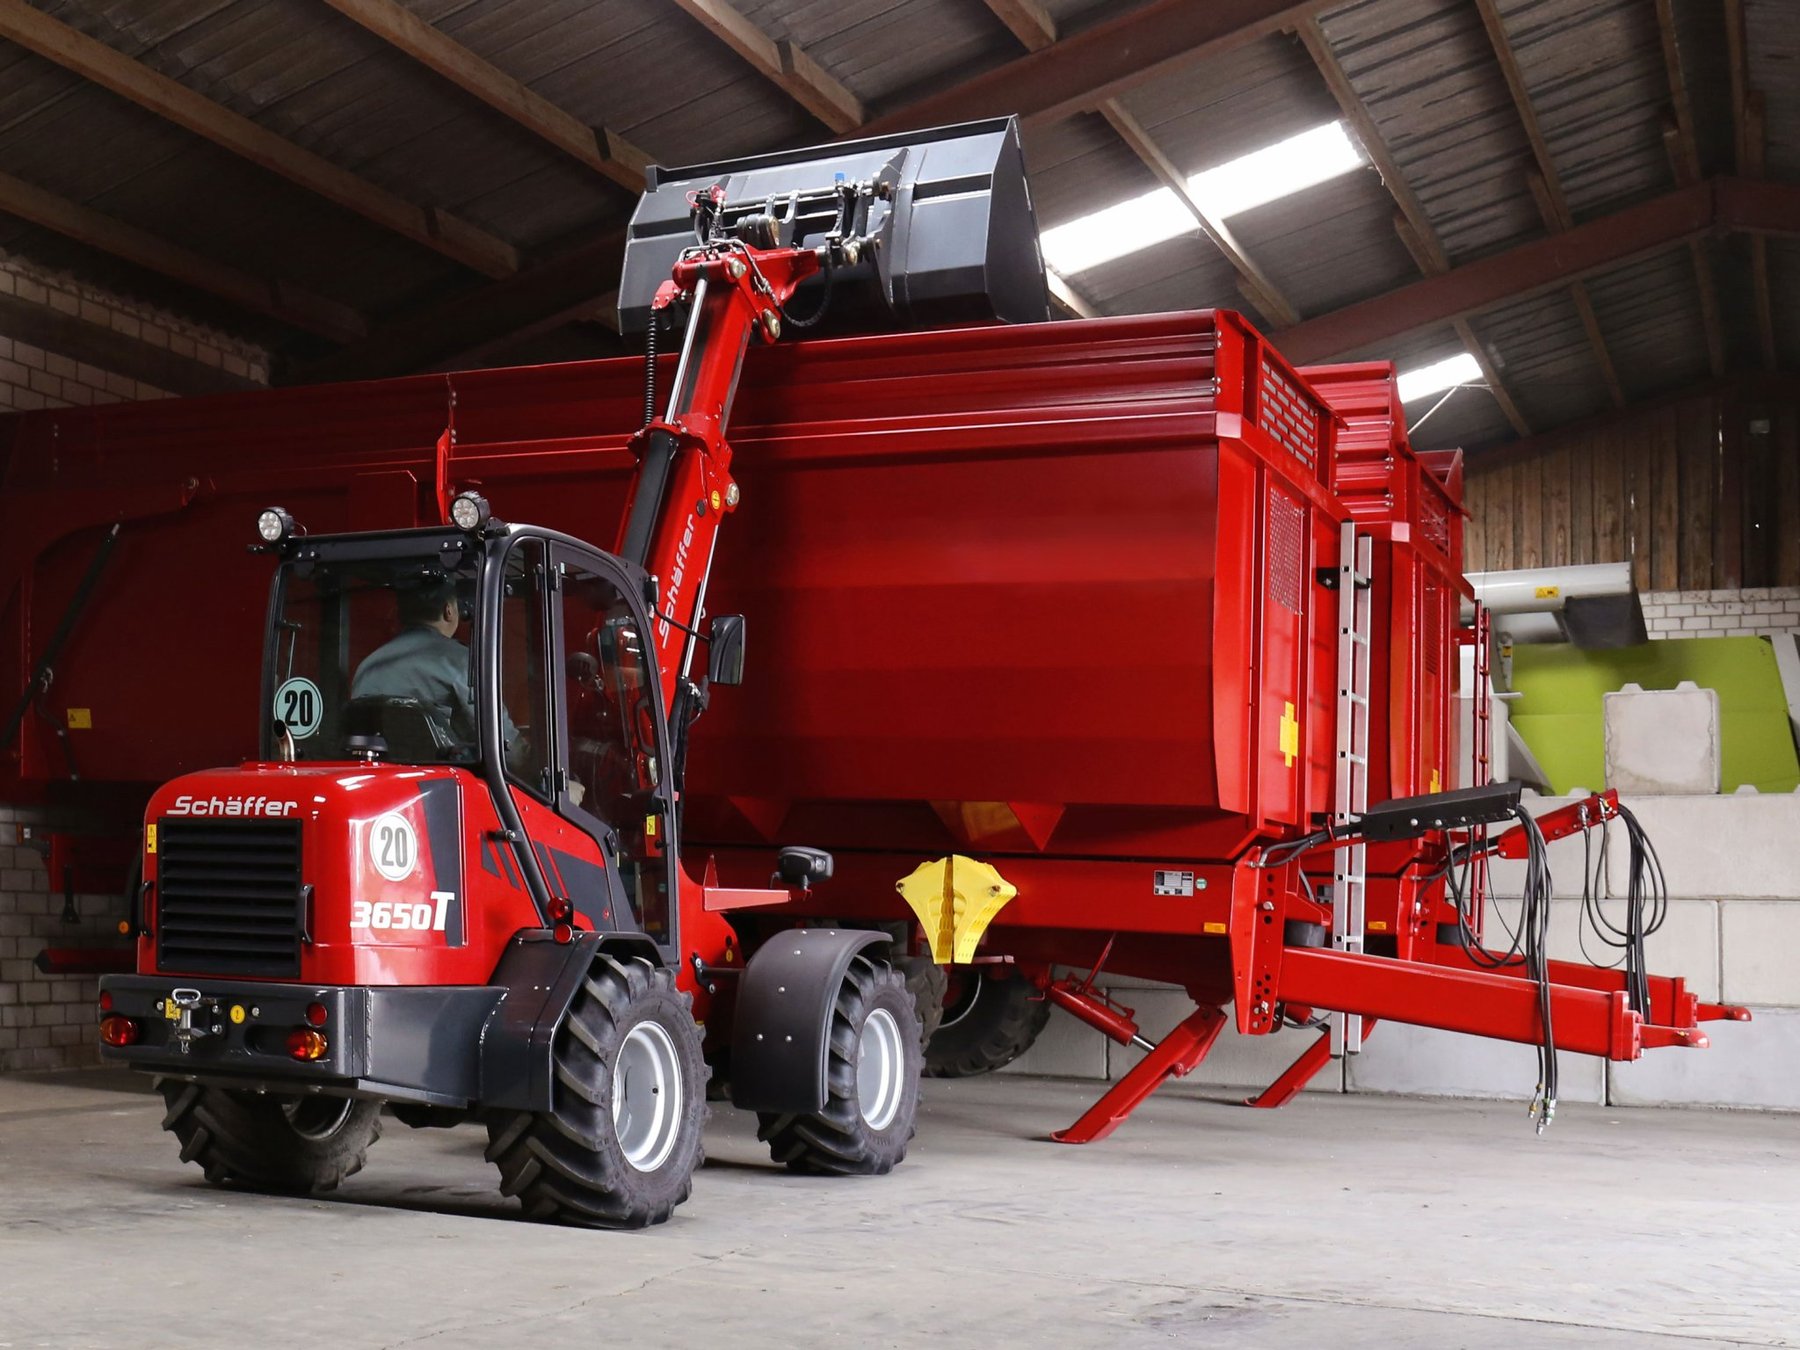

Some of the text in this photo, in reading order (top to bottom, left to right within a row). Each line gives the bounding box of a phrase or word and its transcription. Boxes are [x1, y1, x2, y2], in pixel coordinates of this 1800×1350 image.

[659, 514, 694, 649] Schäffer
[285, 690, 313, 726] 20
[166, 796, 298, 816] Schäffer
[380, 826, 408, 867] 20
[350, 891, 455, 931] 3650T
